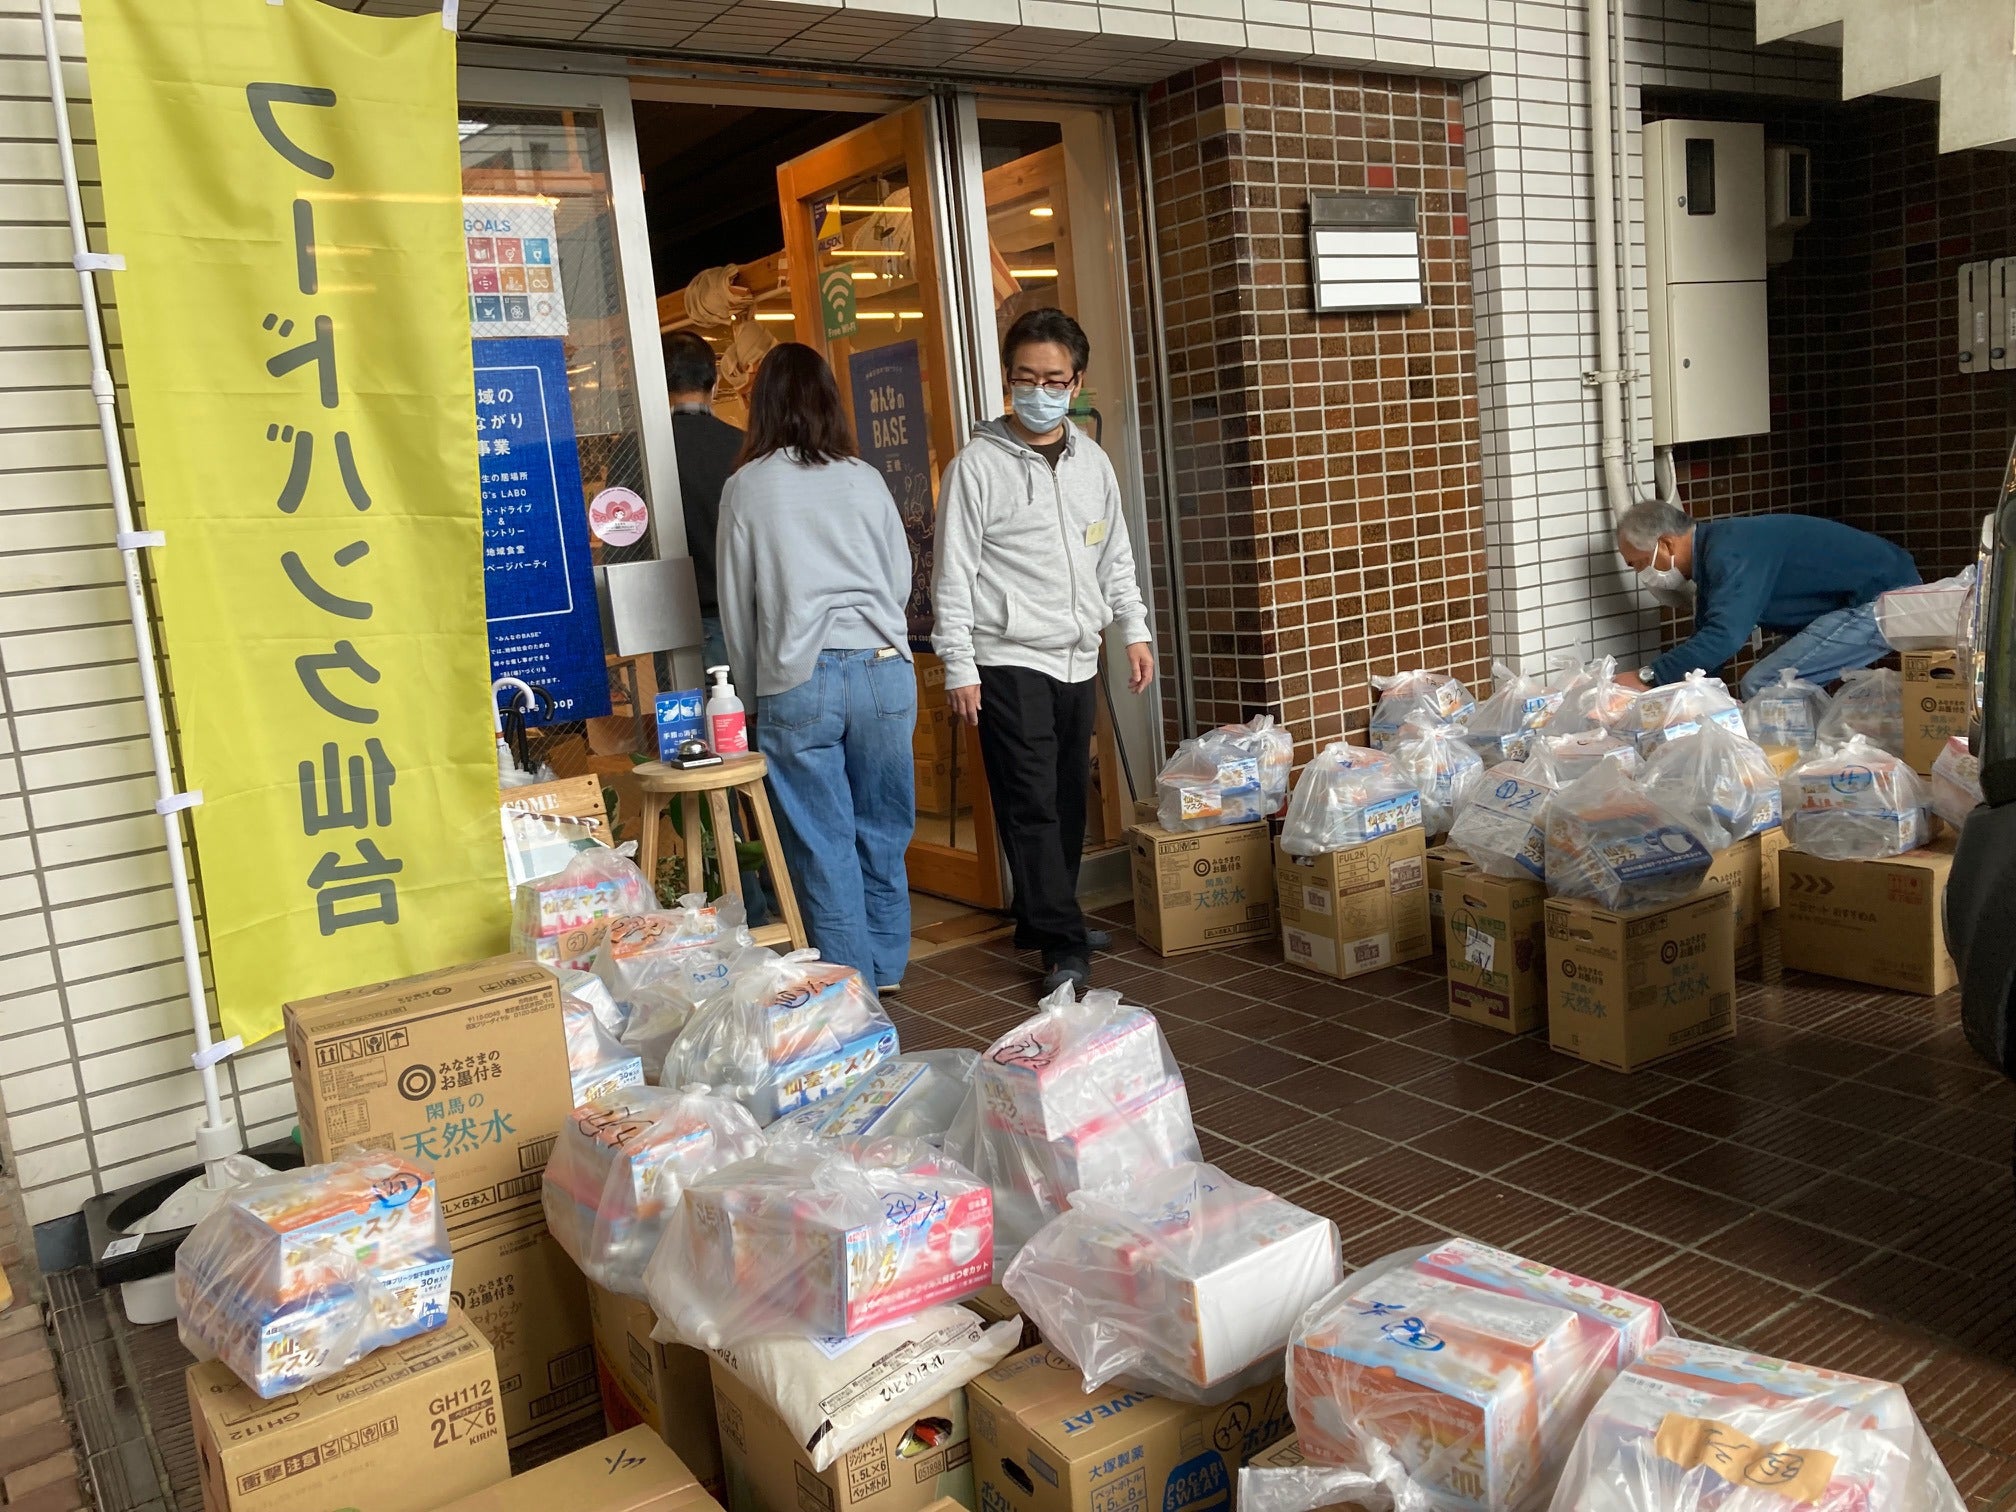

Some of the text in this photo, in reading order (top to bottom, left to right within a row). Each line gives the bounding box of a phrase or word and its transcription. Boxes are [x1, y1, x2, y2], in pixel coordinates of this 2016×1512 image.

[818, 236, 841, 251] ALSOK
[828, 327, 841, 338] Free
[869, 385, 905, 413] みんなの
[872, 415, 909, 449] BASE
[500, 488, 527, 499] LABO
[1193, 885, 1246, 911] 天然水
[439, 1050, 501, 1075] みなさまの
[441, 1063, 503, 1091] お墨付き
[401, 1109, 517, 1161] 天然水
[468, 1274, 514, 1296] みなさまの
[469, 1284, 515, 1310] お墨付き
[488, 1321, 516, 1351] 茶
[428, 1379, 492, 1417] GH112
[230, 1412, 300, 1441] GH112
[468, 1427, 498, 1446] KIRIN
[241, 1450, 319, 1492] 衝撃注意
[1089, 1444, 1145, 1482] 大塚製薬
[853, 1477, 888, 1498] ペットボトル
[1166, 1462, 1225, 1495] POCARI
[1165, 1477, 1221, 1511] SWEAT
